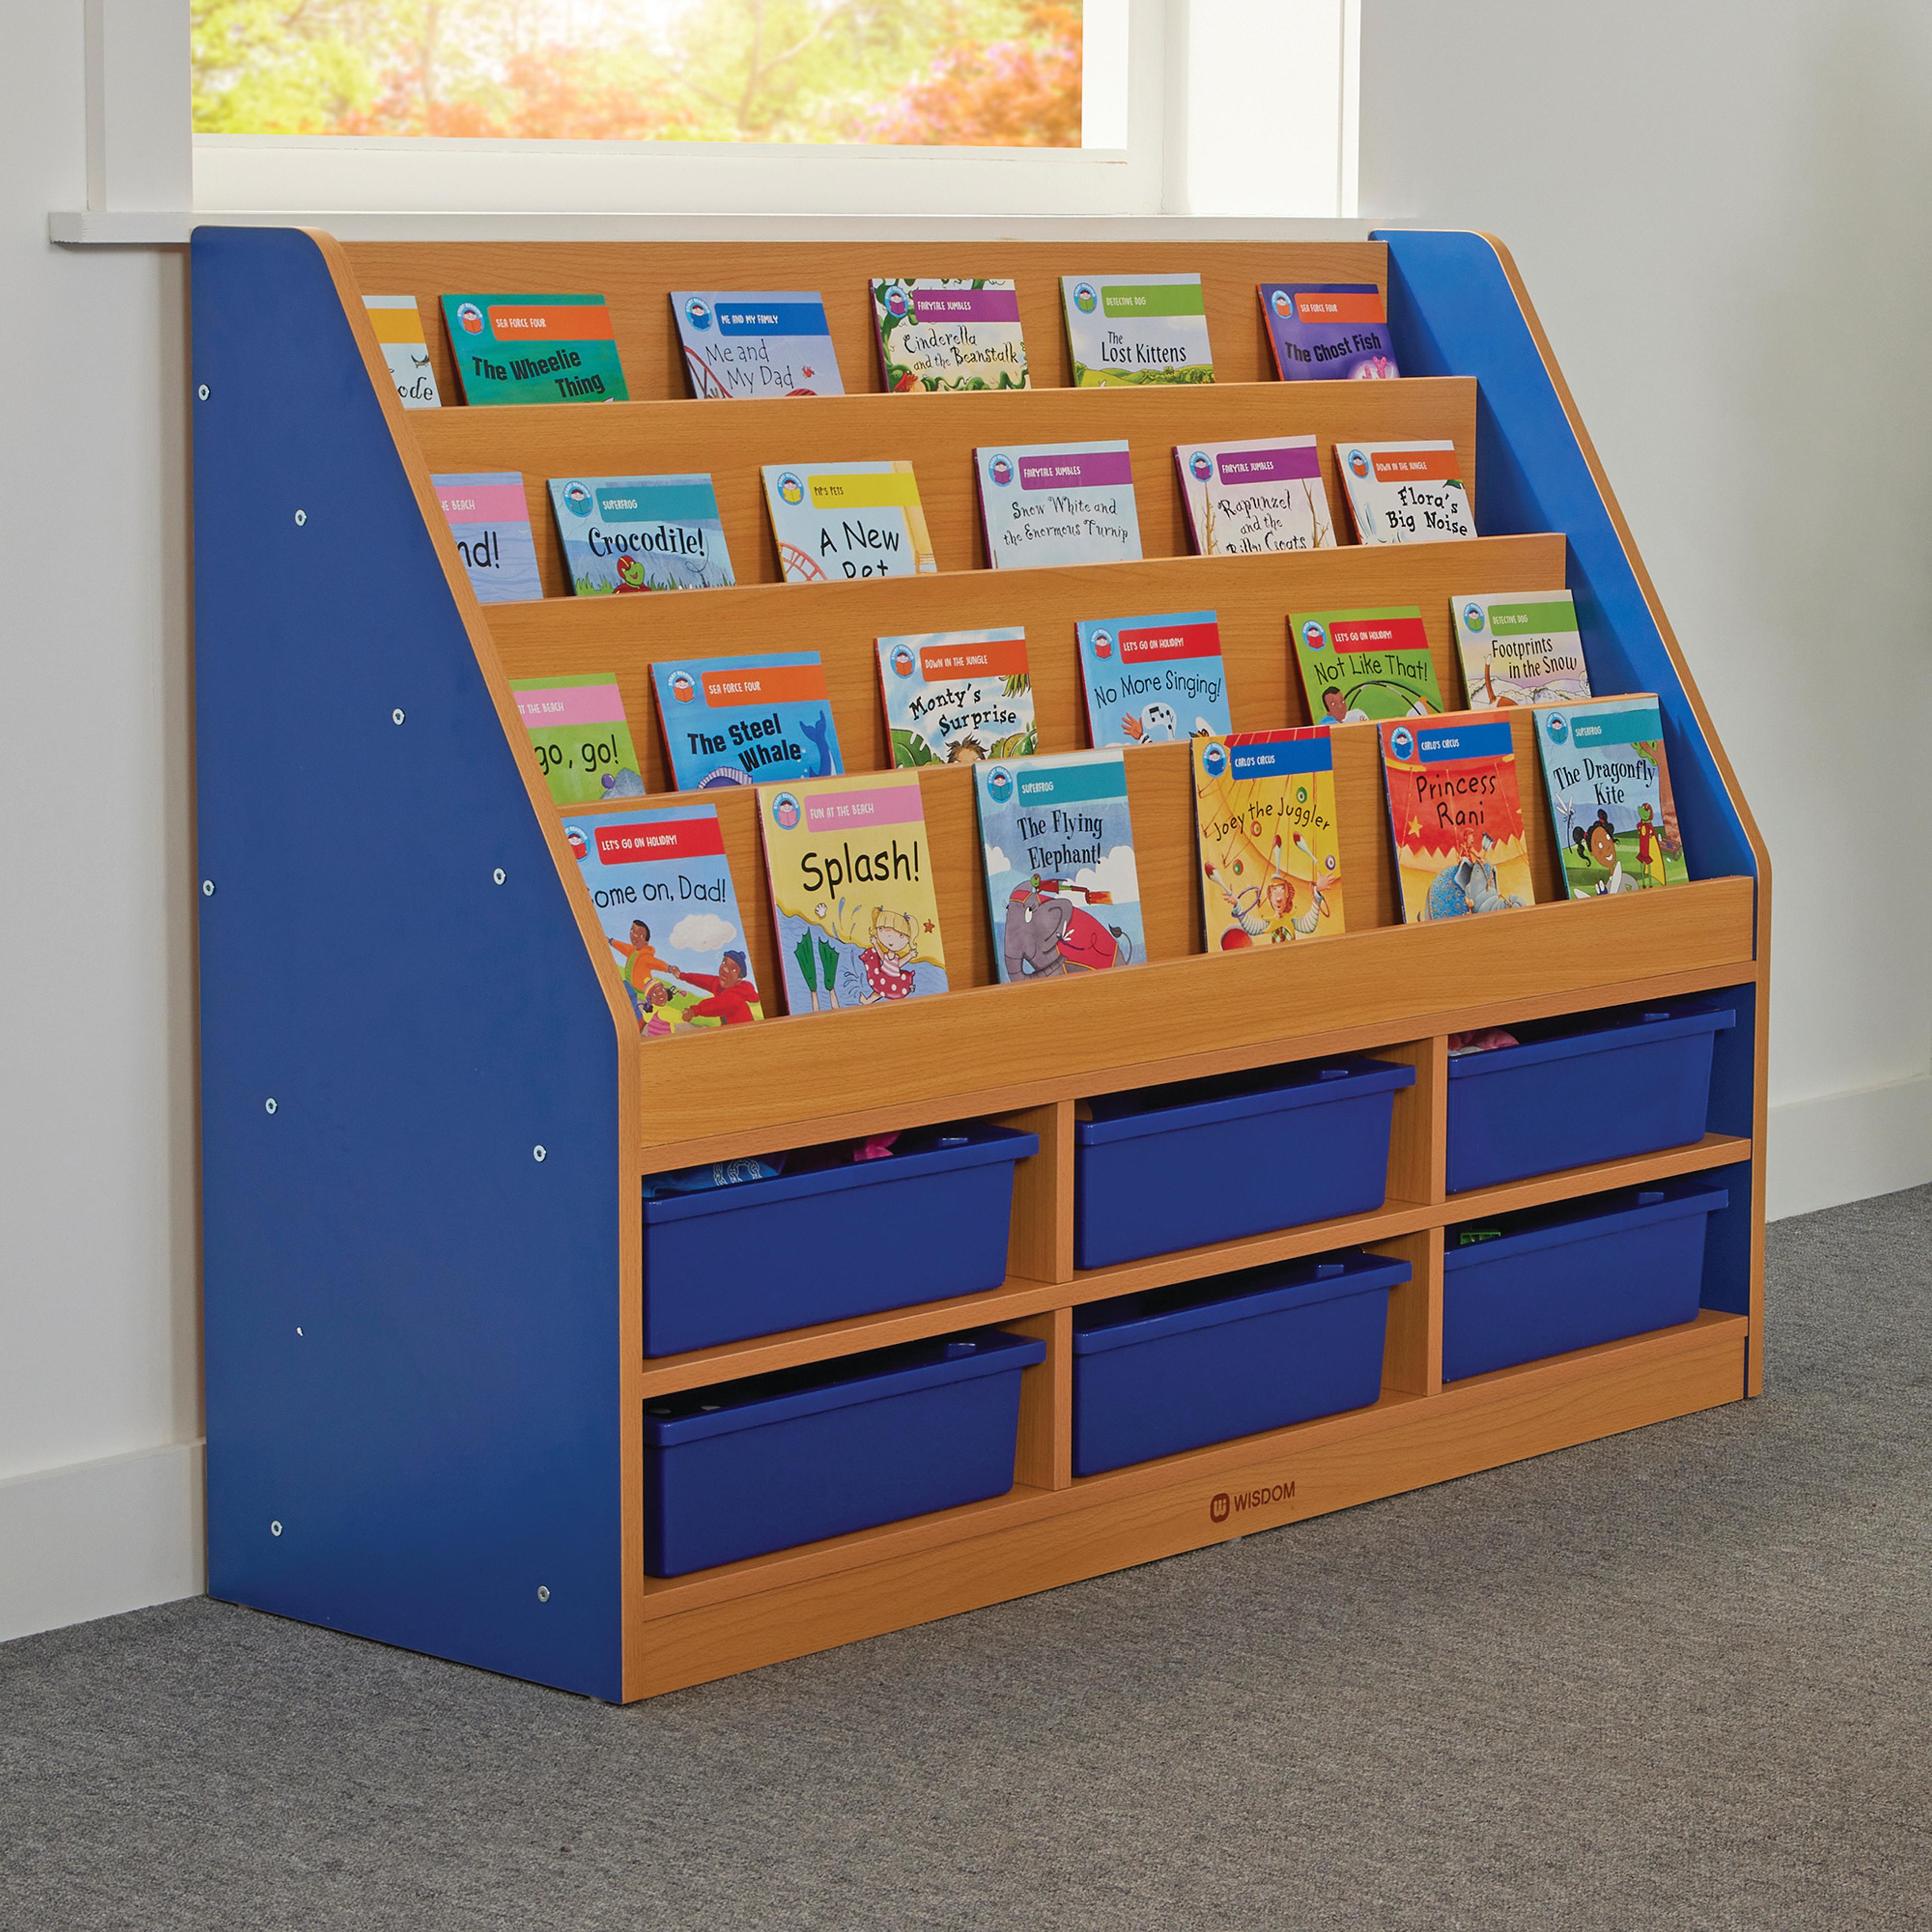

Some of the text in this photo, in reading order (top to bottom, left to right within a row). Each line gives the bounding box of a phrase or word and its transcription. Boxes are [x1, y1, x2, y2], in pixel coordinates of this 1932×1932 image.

[917, 301, 945, 310] FAIRYTALE
[1106, 297, 1146, 306] DETECTIVE DOG
[1300, 304, 1310, 312] SEA
[1326, 304, 1337, 312] FOUR
[496, 318, 546, 328] SEA FORCE FOUR
[721, 314, 778, 324] ME AND MY FAMILY
[903, 325, 977, 353] Cinderella
[1108, 331, 1122, 344] The
[1285, 332, 1382, 363] The Ghost Fish
[705, 339, 770, 365] Me and
[914, 341, 1019, 371] and the Beanstalk
[1102, 342, 1187, 363] Lost Kittens
[472, 350, 582, 380] The Wheelie
[555, 374, 605, 398] Thing
[727, 365, 794, 393] My Dad
[1023, 468, 1053, 478] FAIRYTALE
[1222, 463, 1249, 473] FAIRYTALE
[1376, 462, 1427, 471] DOWN IN THE JUNGLE
[814, 487, 844, 496] PIP'S PETS
[1398, 486, 1458, 514] Flora's
[451, 499, 475, 511] BEACH
[603, 499, 638, 510] SUPERFROG
[1012, 496, 1117, 520] Snow White and
[1218, 489, 1292, 520] Rapunzel
[1003, 519, 1129, 546] the Enormous Turnip
[1240, 513, 1283, 535] and the
[1386, 510, 1467, 536] Big Noise
[588, 525, 705, 557] Crocodile!
[821, 520, 899, 557] A New
[1492, 614, 1528, 625] DETECTIVE DOG
[1123, 637, 1184, 652] LET'S GO ON HOLIDAY!
[1335, 630, 1392, 642] LET'S GO ON HOLIDAY!
[1492, 638, 1553, 660] Footprints
[925, 655, 988, 668] DOWN IN THE JUNGLE
[1314, 653, 1427, 685] Not Like That!
[1509, 656, 1577, 679] in the Snow
[709, 681, 761, 695] SEA FORCE FOUR
[1094, 670, 1221, 709] No More Singing!
[527, 704, 541, 714] THE
[542, 702, 565, 712] BEACH
[909, 683, 981, 721] Monty's
[938, 705, 1016, 737] Surprise
[1575, 726, 1602, 737] SUPERFROG
[687, 713, 782, 755] The Steel
[1421, 739, 1460, 751] CARLO'S CIRCUS
[582, 734, 618, 772] go!
[738, 739, 802, 773] Whale
[1235, 755, 1275, 768] CARLO'S CIRCUS
[1553, 758, 1656, 791] The Dragonfly
[1022, 781, 1054, 794] SUPERFROG
[1416, 774, 1496, 802] Princess
[1594, 782, 1625, 806] Kite
[811, 803, 874, 819] FUN AT THE BEACH
[1214, 797, 1330, 841] Joey the Juggler
[1436, 800, 1484, 829] Rani
[1017, 809, 1103, 842] The Flying
[602, 835, 677, 851] LET'S GO ON HOLIDAY!
[1027, 842, 1101, 873] Elephant!
[801, 840, 919, 900] Splash!
[587, 874, 726, 908] ome on, Dad!
[1234, 1481, 1295, 1512] WISDOM
